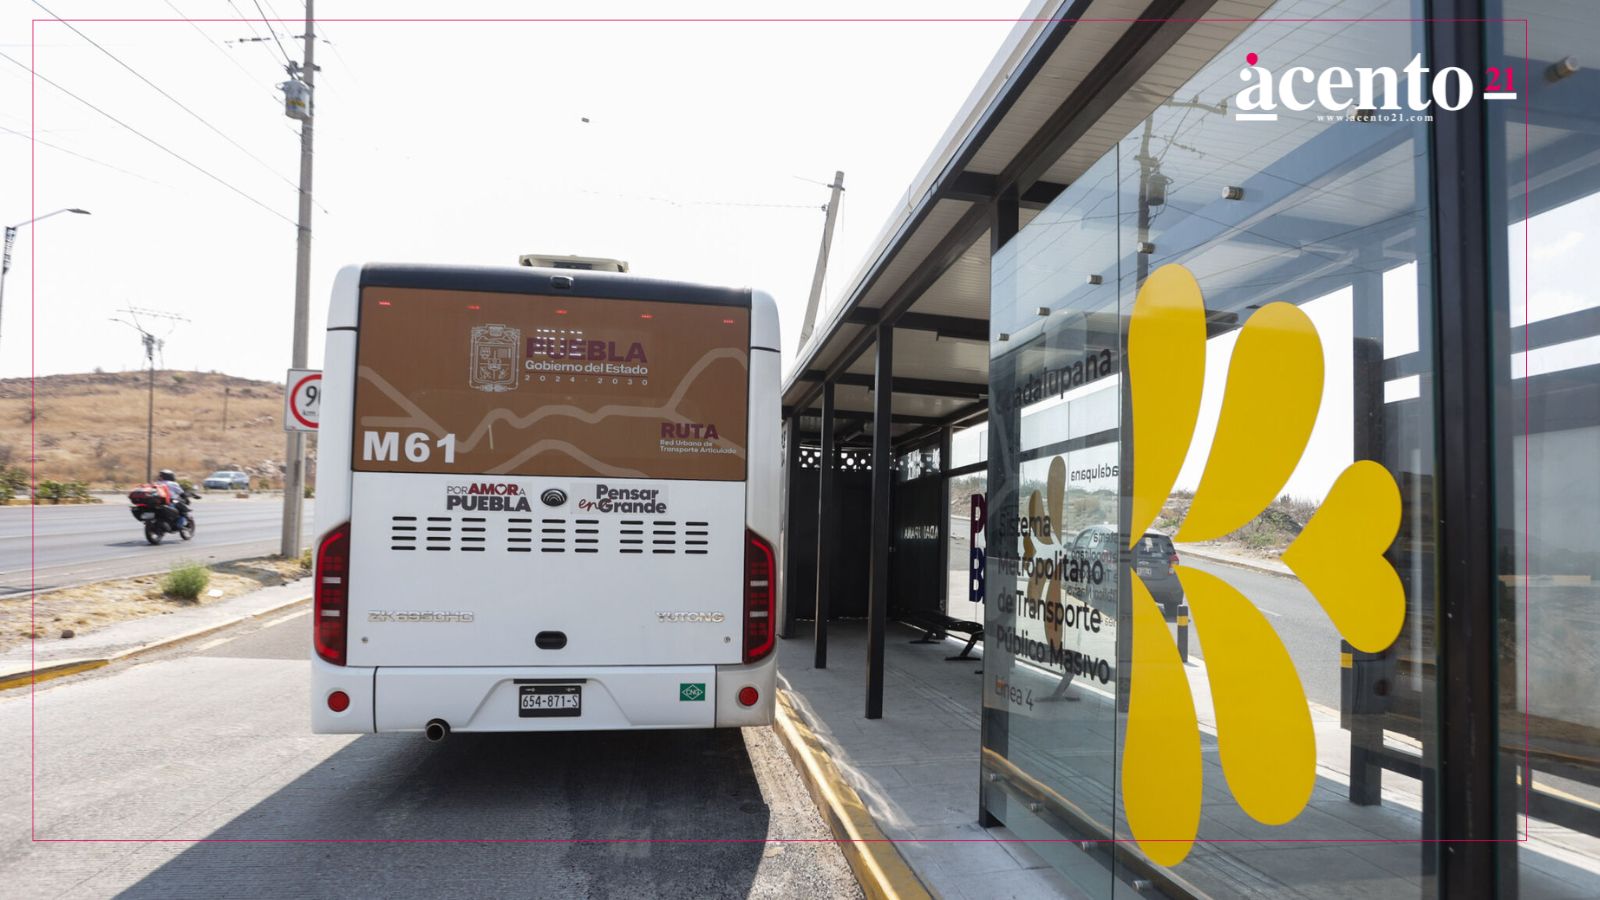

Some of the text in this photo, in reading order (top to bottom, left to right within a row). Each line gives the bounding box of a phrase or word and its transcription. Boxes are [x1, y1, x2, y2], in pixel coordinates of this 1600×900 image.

[526, 338, 648, 363] PUEBLA
[525, 360, 648, 375] Gobierno del Estado
[305, 385, 321, 407] 9
[661, 422, 719, 440] RUTA
[363, 431, 456, 464] M61
[660, 446, 737, 454] Transporte Articulado
[446, 485, 468, 494] POR
[468, 483, 519, 495] AMOR
[596, 484, 659, 500] Pensar
[446, 495, 532, 512] PUEBLA
[599, 498, 667, 513] Grande
[998, 550, 1104, 585] Metropolitano
[656, 611, 724, 623] YUTONG
[997, 591, 1014, 615] de
[1016, 590, 1102, 634] Transporte
[996, 625, 1111, 685] Público Masivo
[522, 694, 579, 708] 654-871-S
[1025, 689, 1034, 711] 4
